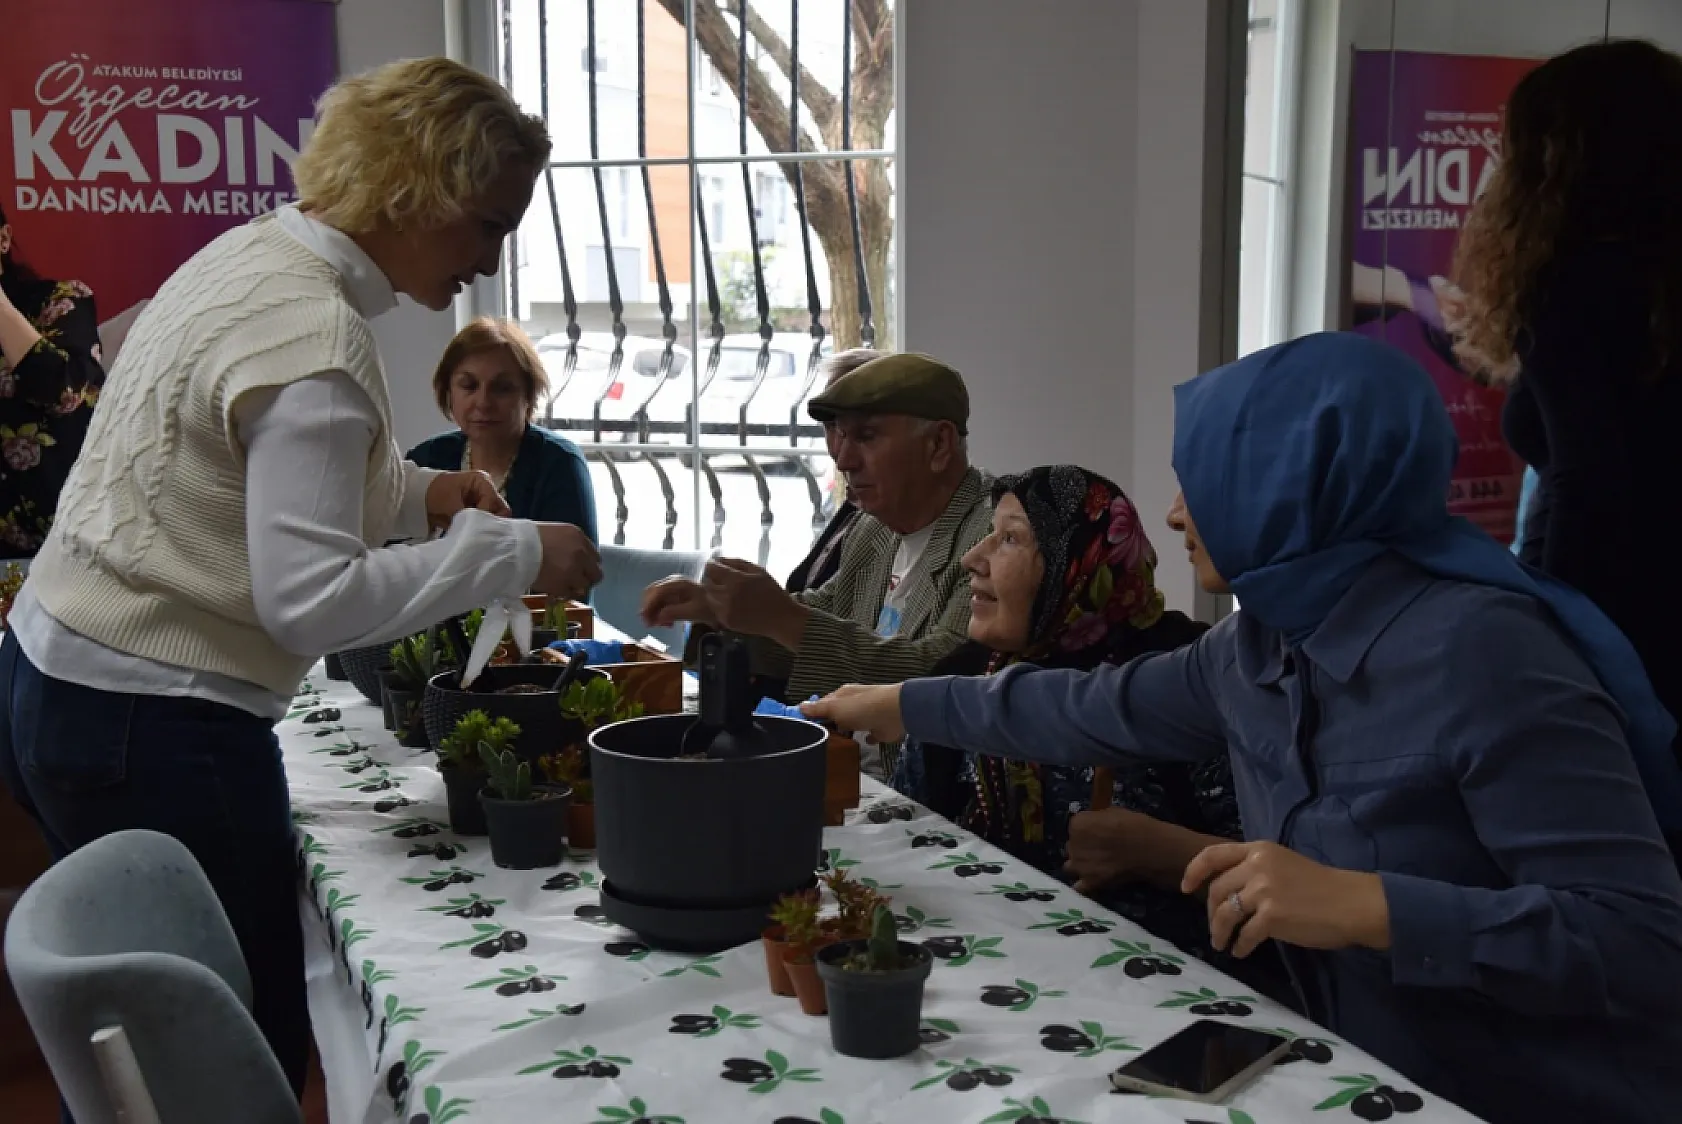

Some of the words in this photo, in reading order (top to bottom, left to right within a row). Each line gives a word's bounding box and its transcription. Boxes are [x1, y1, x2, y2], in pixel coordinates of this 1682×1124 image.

[92, 65, 158, 78] ATAKUM
[162, 66, 243, 81] BELEDİYESİ
[34, 52, 260, 149] Özgecan
[11, 110, 315, 186] KADIN
[16, 186, 172, 215] DANIŞMA
[183, 190, 299, 216] MERKE
